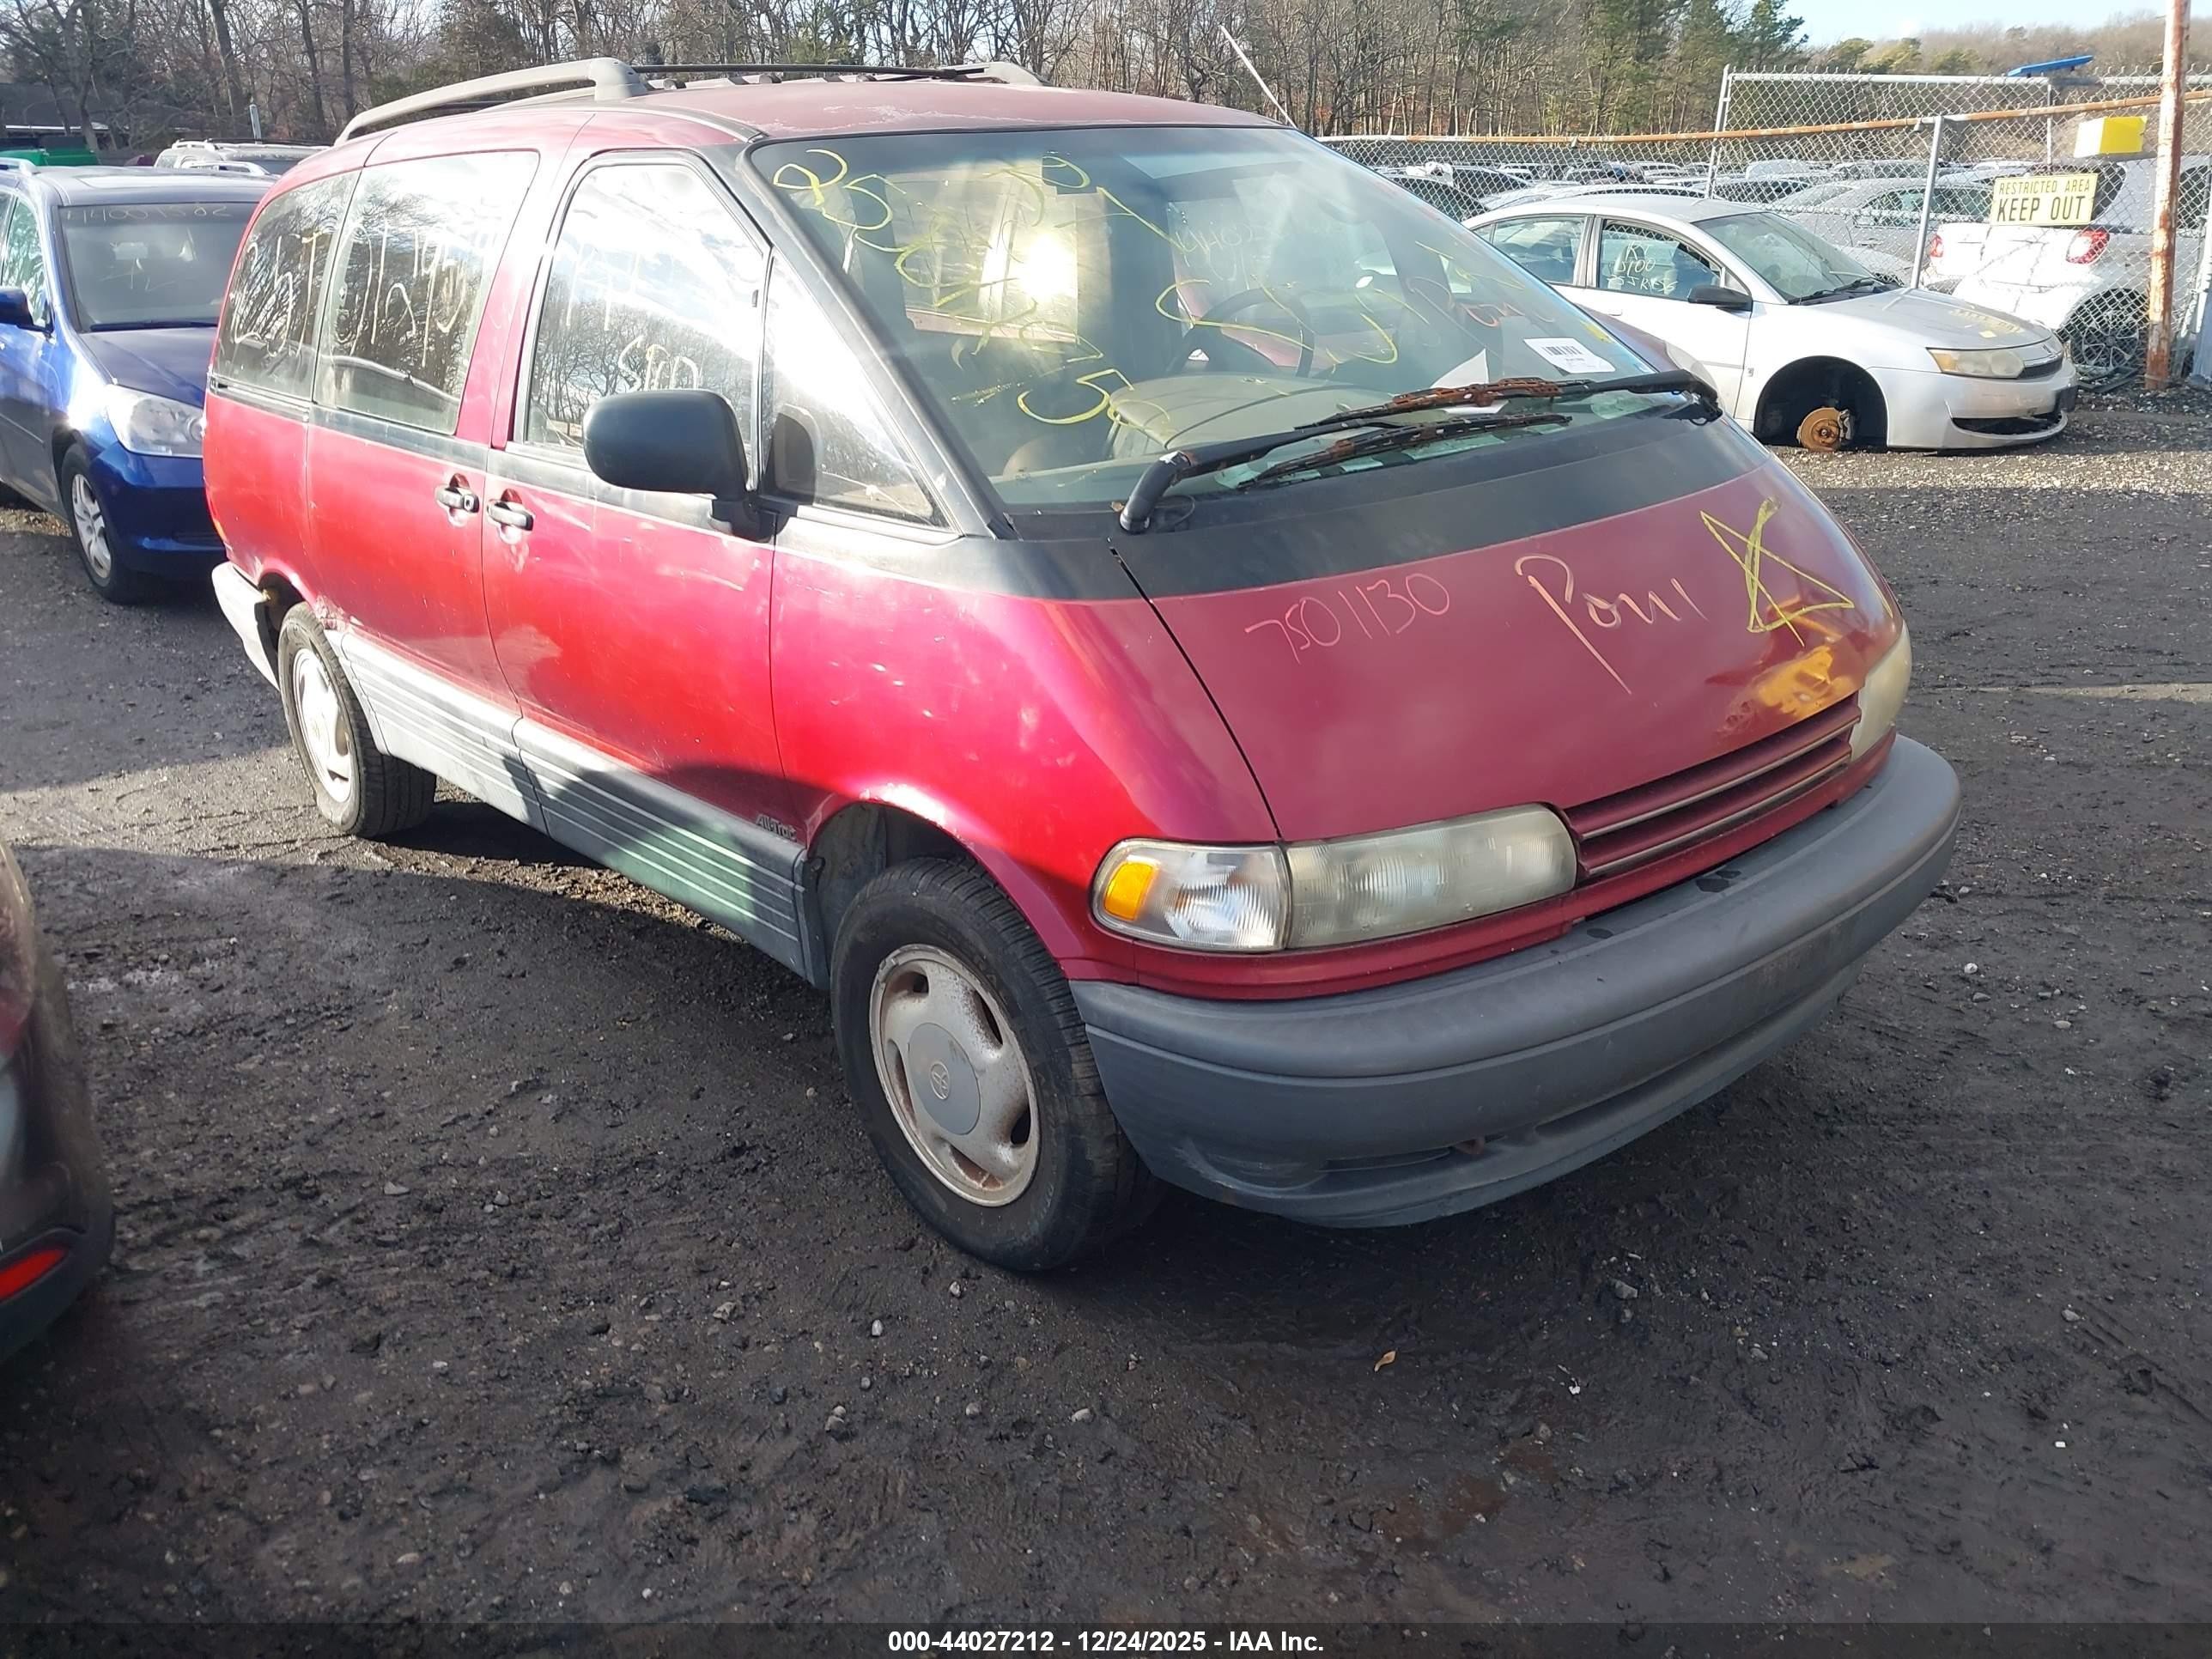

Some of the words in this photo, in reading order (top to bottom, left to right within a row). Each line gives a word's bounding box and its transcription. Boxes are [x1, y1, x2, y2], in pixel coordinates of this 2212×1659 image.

[1999, 180, 2057, 195] RESTRICTED
[2064, 179, 2090, 192] AREA
[1996, 198, 2040, 222] KEEP
[2050, 196, 2085, 221] OUT
